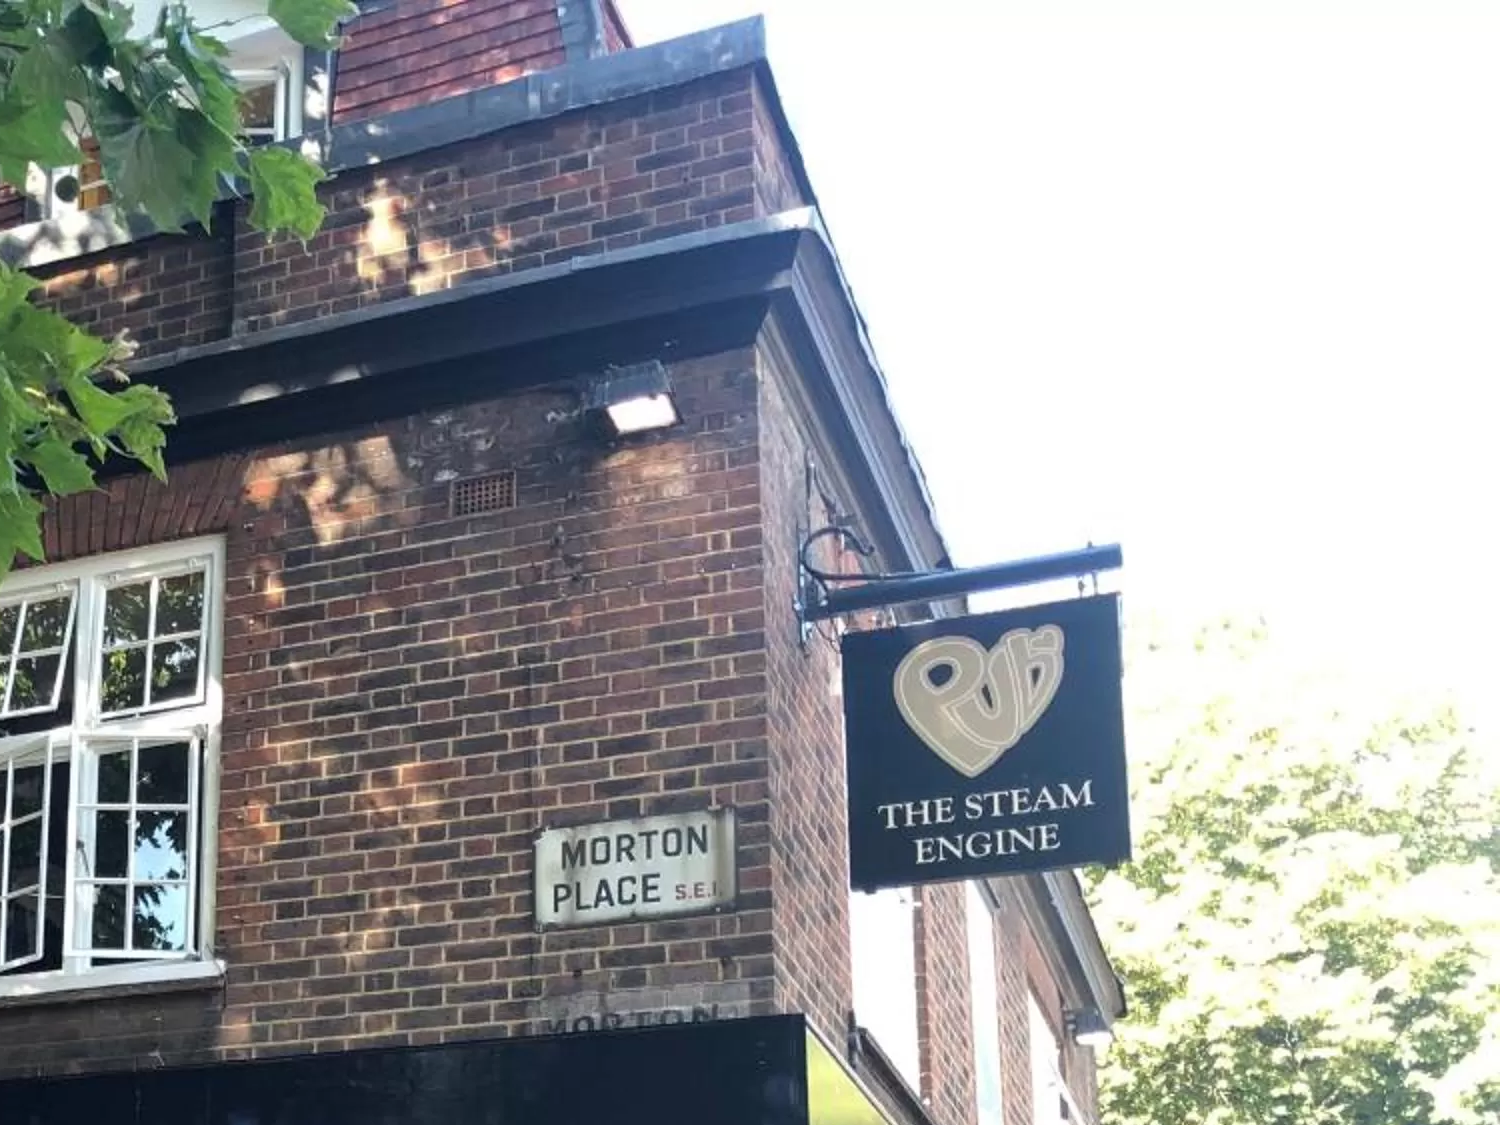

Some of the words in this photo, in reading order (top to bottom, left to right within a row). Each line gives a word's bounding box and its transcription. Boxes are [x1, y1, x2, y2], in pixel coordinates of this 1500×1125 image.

[878, 797, 955, 829] THE
[965, 780, 1094, 820] STEAM
[561, 824, 708, 870] MORTON
[912, 823, 1061, 864] ENGINE
[553, 873, 661, 913] PLACE
